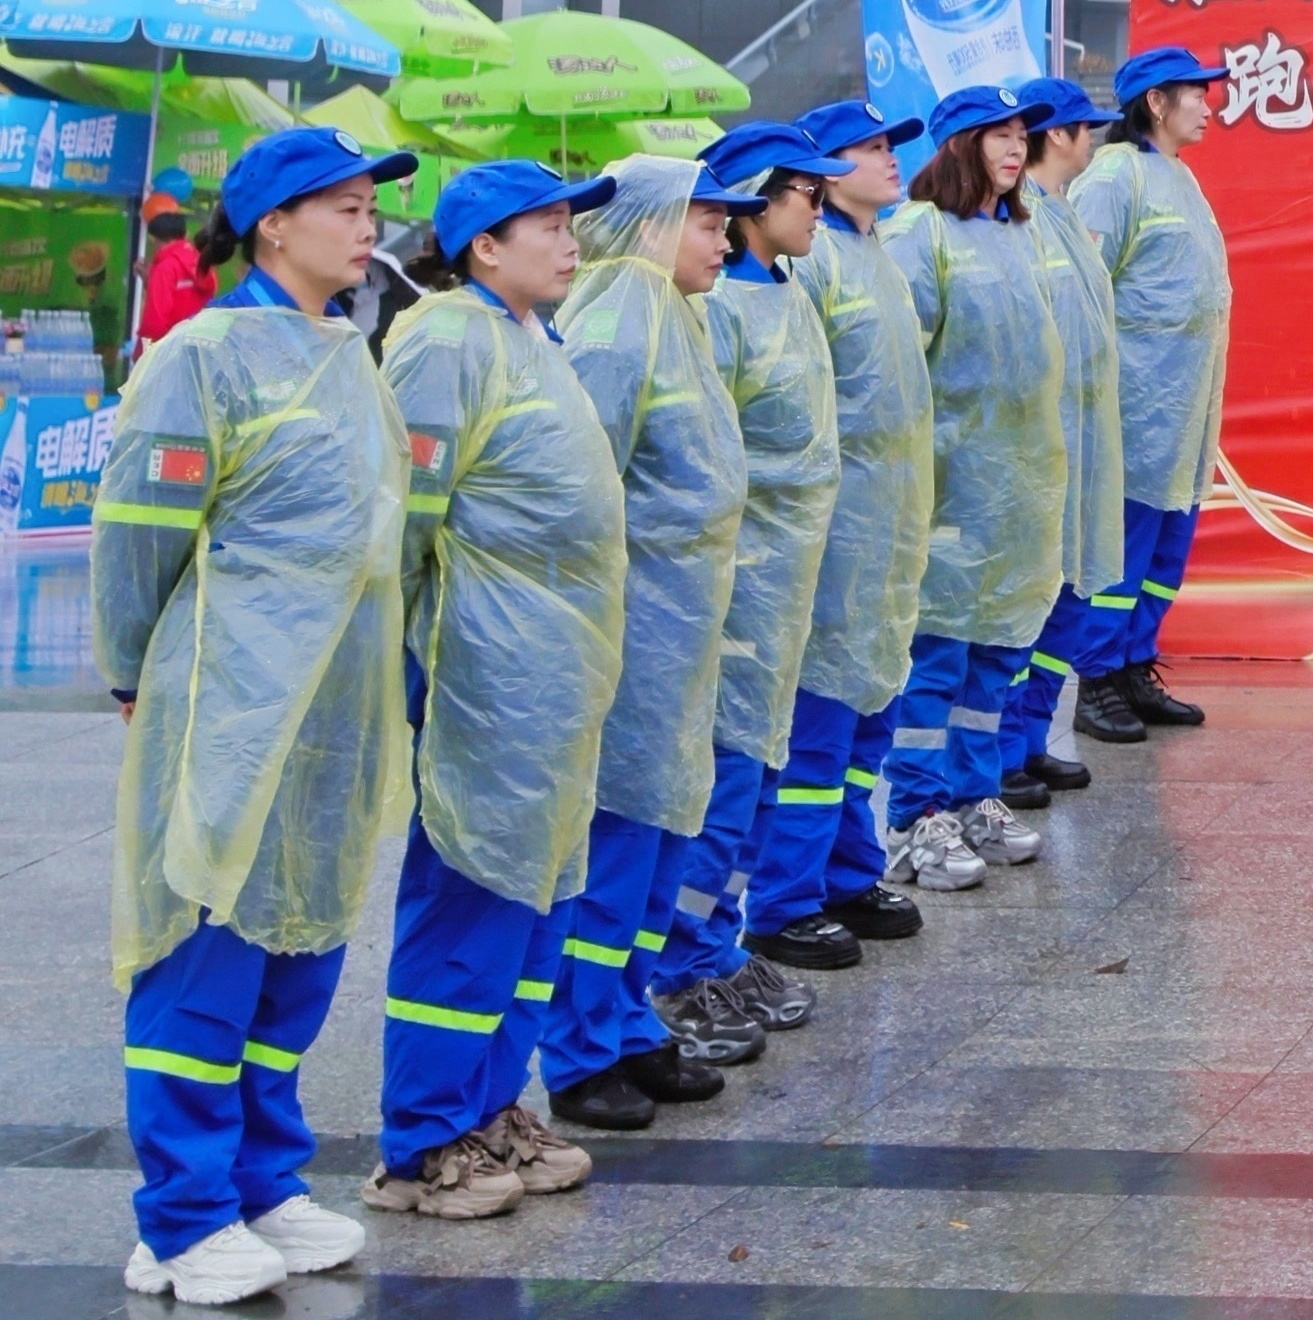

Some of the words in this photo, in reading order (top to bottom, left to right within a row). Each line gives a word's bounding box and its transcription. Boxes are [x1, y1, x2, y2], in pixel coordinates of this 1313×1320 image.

[59, 114, 118, 159] 电解质
[35, 404, 120, 479] 电解质
